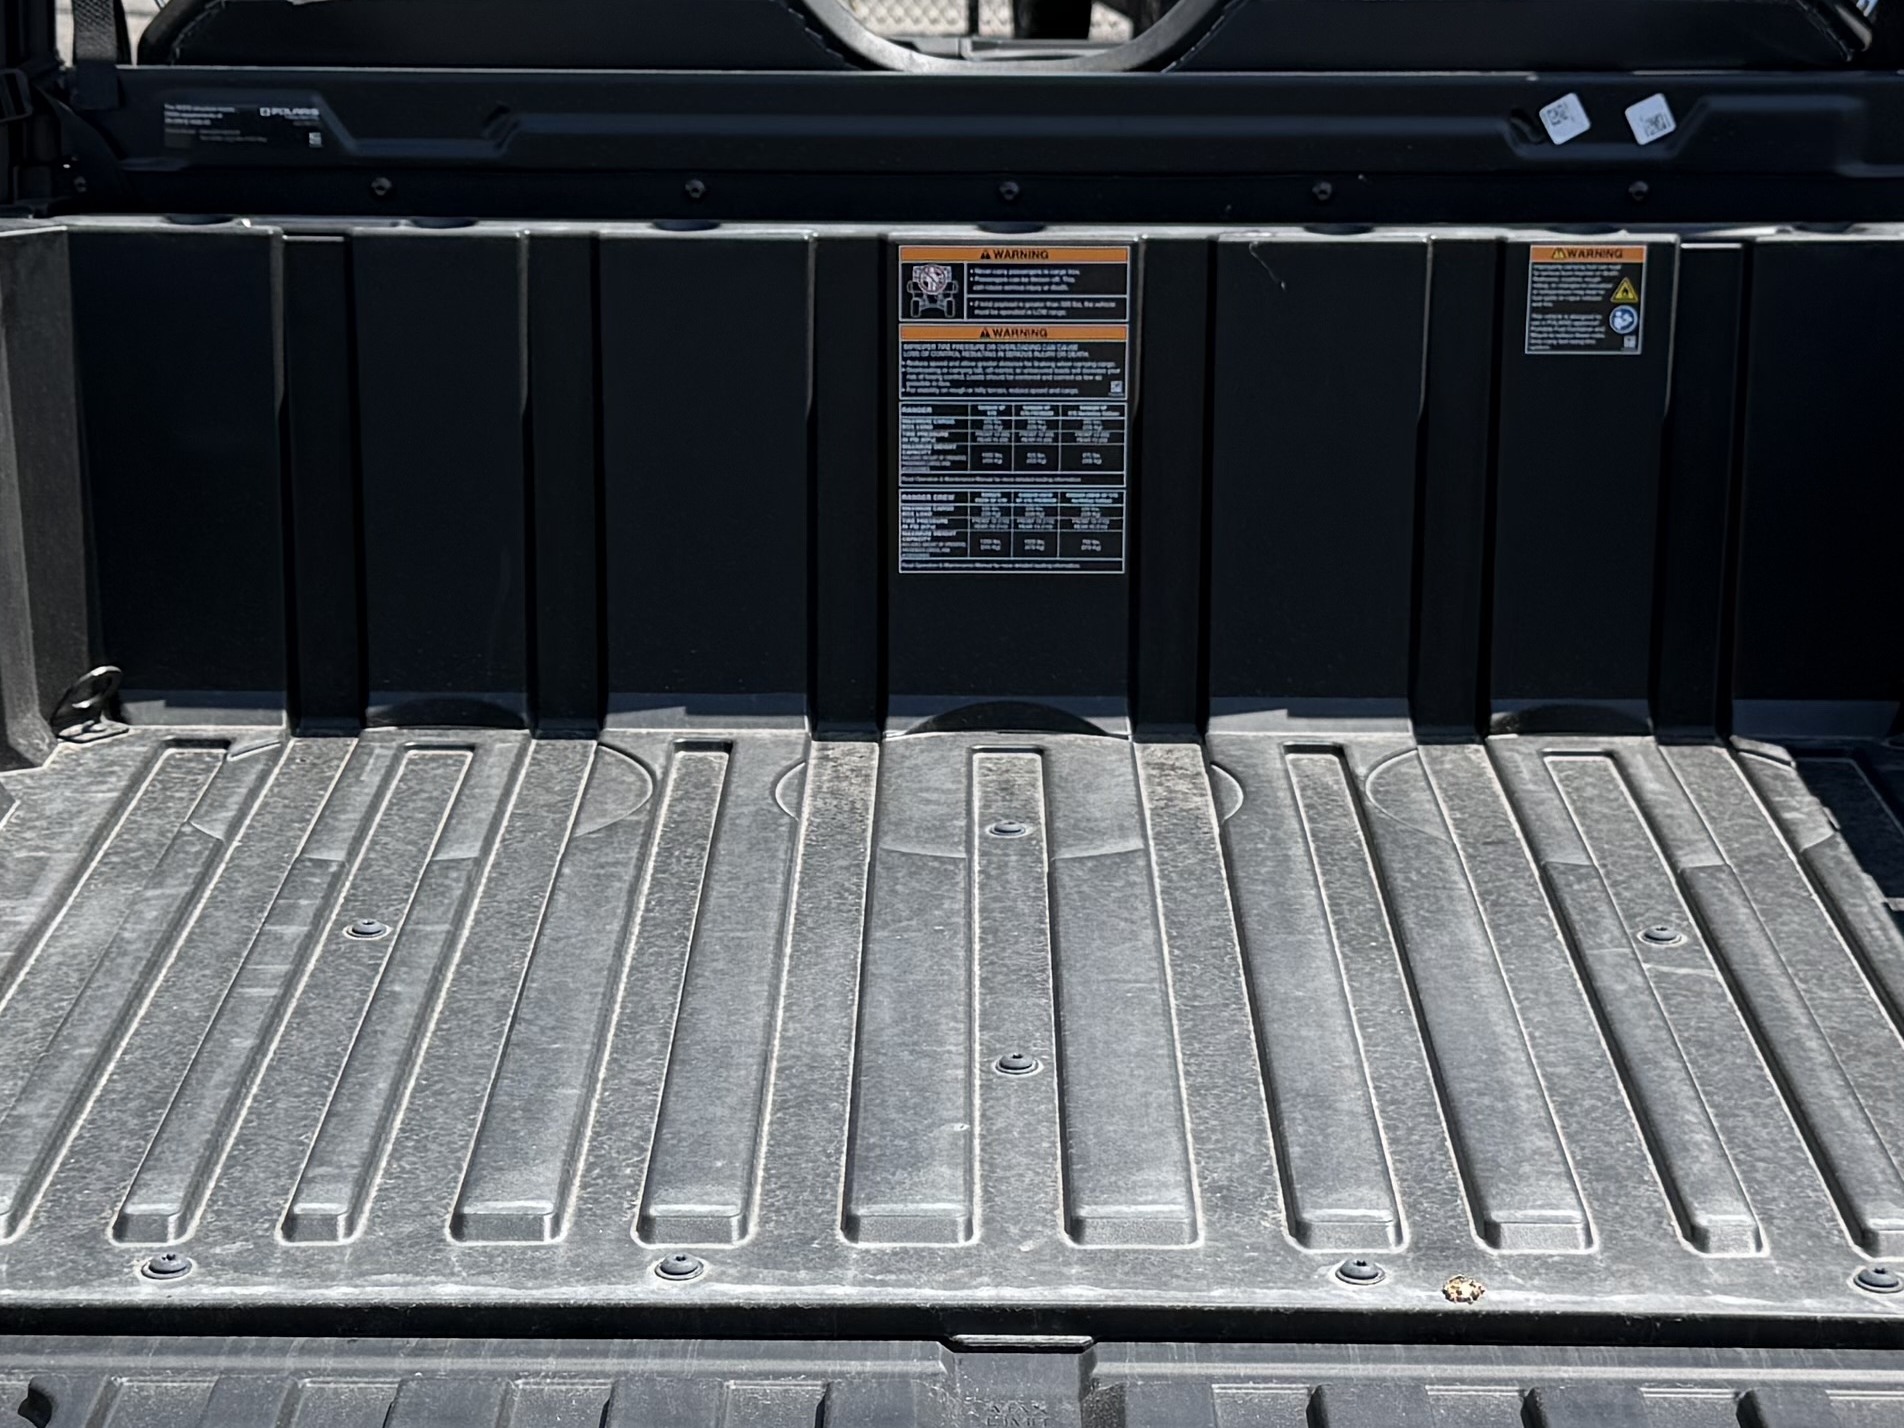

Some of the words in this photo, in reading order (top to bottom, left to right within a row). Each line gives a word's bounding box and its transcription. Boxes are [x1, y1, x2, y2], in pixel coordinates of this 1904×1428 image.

[993, 249, 1050, 260] WARNING
[1567, 248, 1623, 259] WARNING
[992, 327, 1049, 339] WARNING
